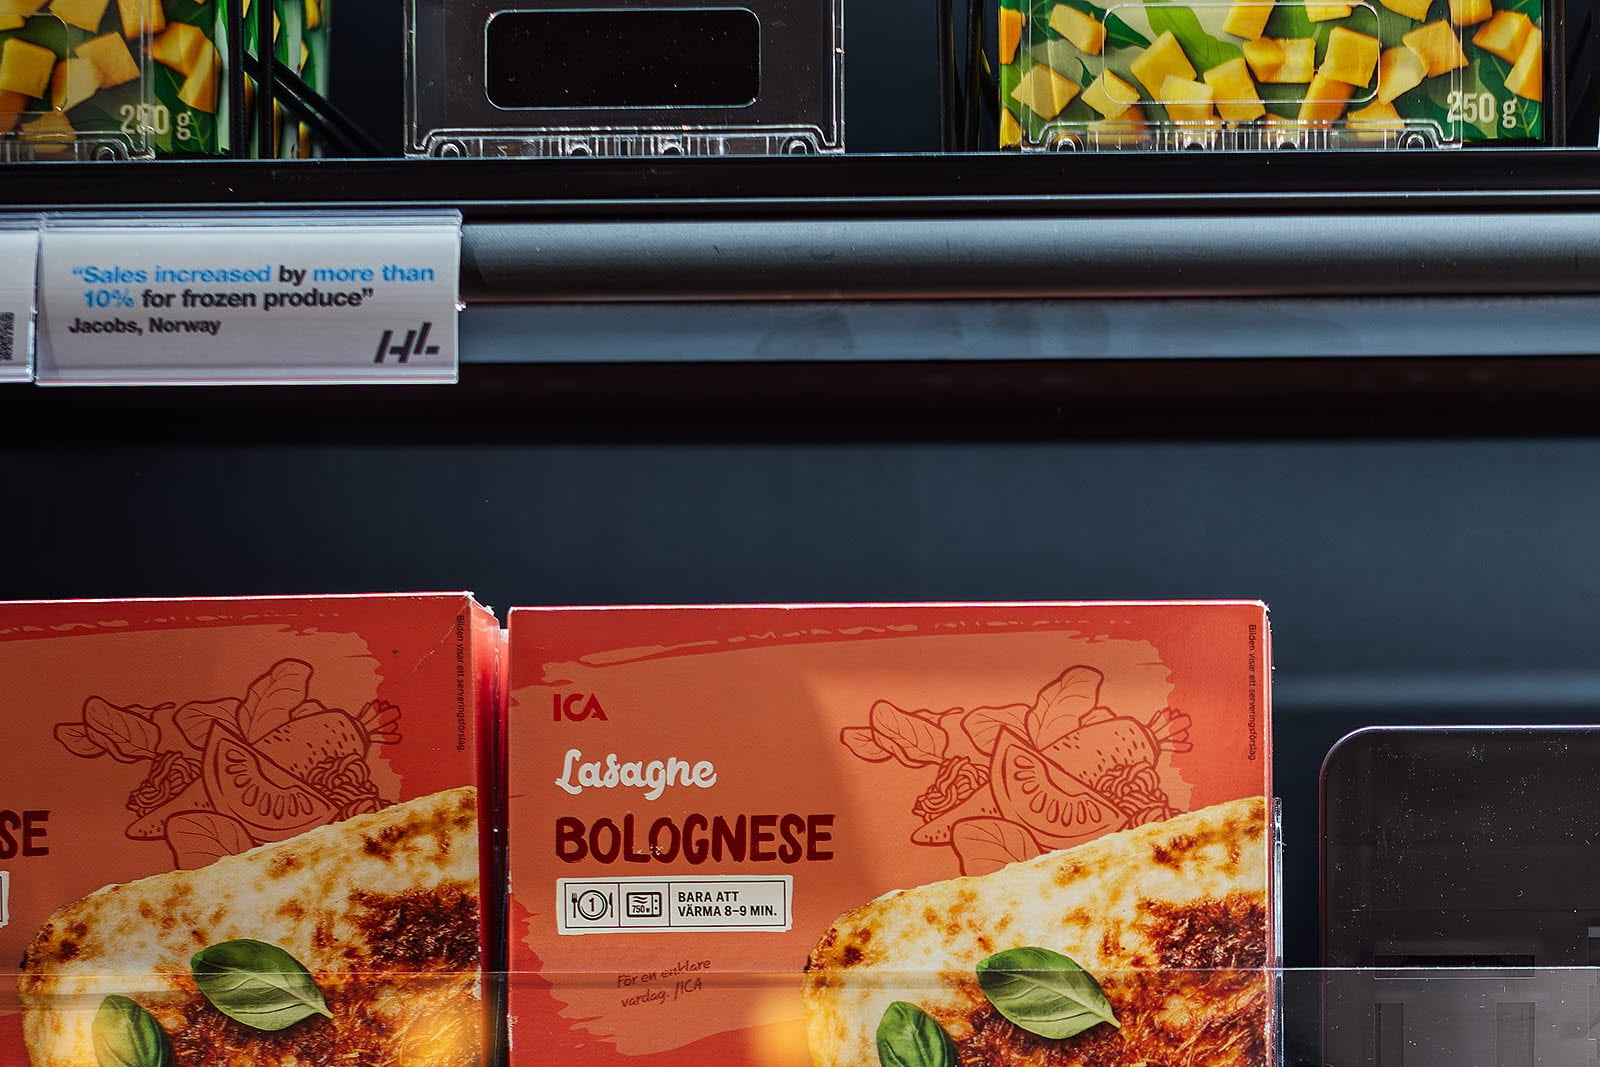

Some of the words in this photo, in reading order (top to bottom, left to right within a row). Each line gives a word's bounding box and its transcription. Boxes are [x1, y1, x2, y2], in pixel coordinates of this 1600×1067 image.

[1447, 90, 1496, 123] 250
[1502, 95, 1518, 129] g
[177, 110, 192, 140] g
[155, 265, 271, 283] increased
[279, 266, 307, 286] by
[313, 268, 374, 282] more
[382, 265, 435, 282] than
[83, 290, 135, 308] 10%
[141, 289, 172, 308] for
[181, 288, 257, 308] frozen
[68, 318, 143, 336] Jacobs,
[149, 318, 221, 336] Norway
[456, 615, 466, 642] Bilden
[456, 643, 466, 663] visar
[456, 665, 466, 677] ett
[553, 693, 609, 722] ICA
[554, 749, 717, 801] Lasagne
[555, 813, 837, 866] BOLOGNESE
[678, 892, 713, 903] BARA
[716, 891, 739, 902] ATT
[678, 904, 722, 917] VÄRMA
[750, 905, 778, 917] MIN.
[617, 971, 637, 989] För
[641, 970, 657, 984] en
[661, 958, 712, 978] enklare
[621, 990, 670, 1008] vardag.
